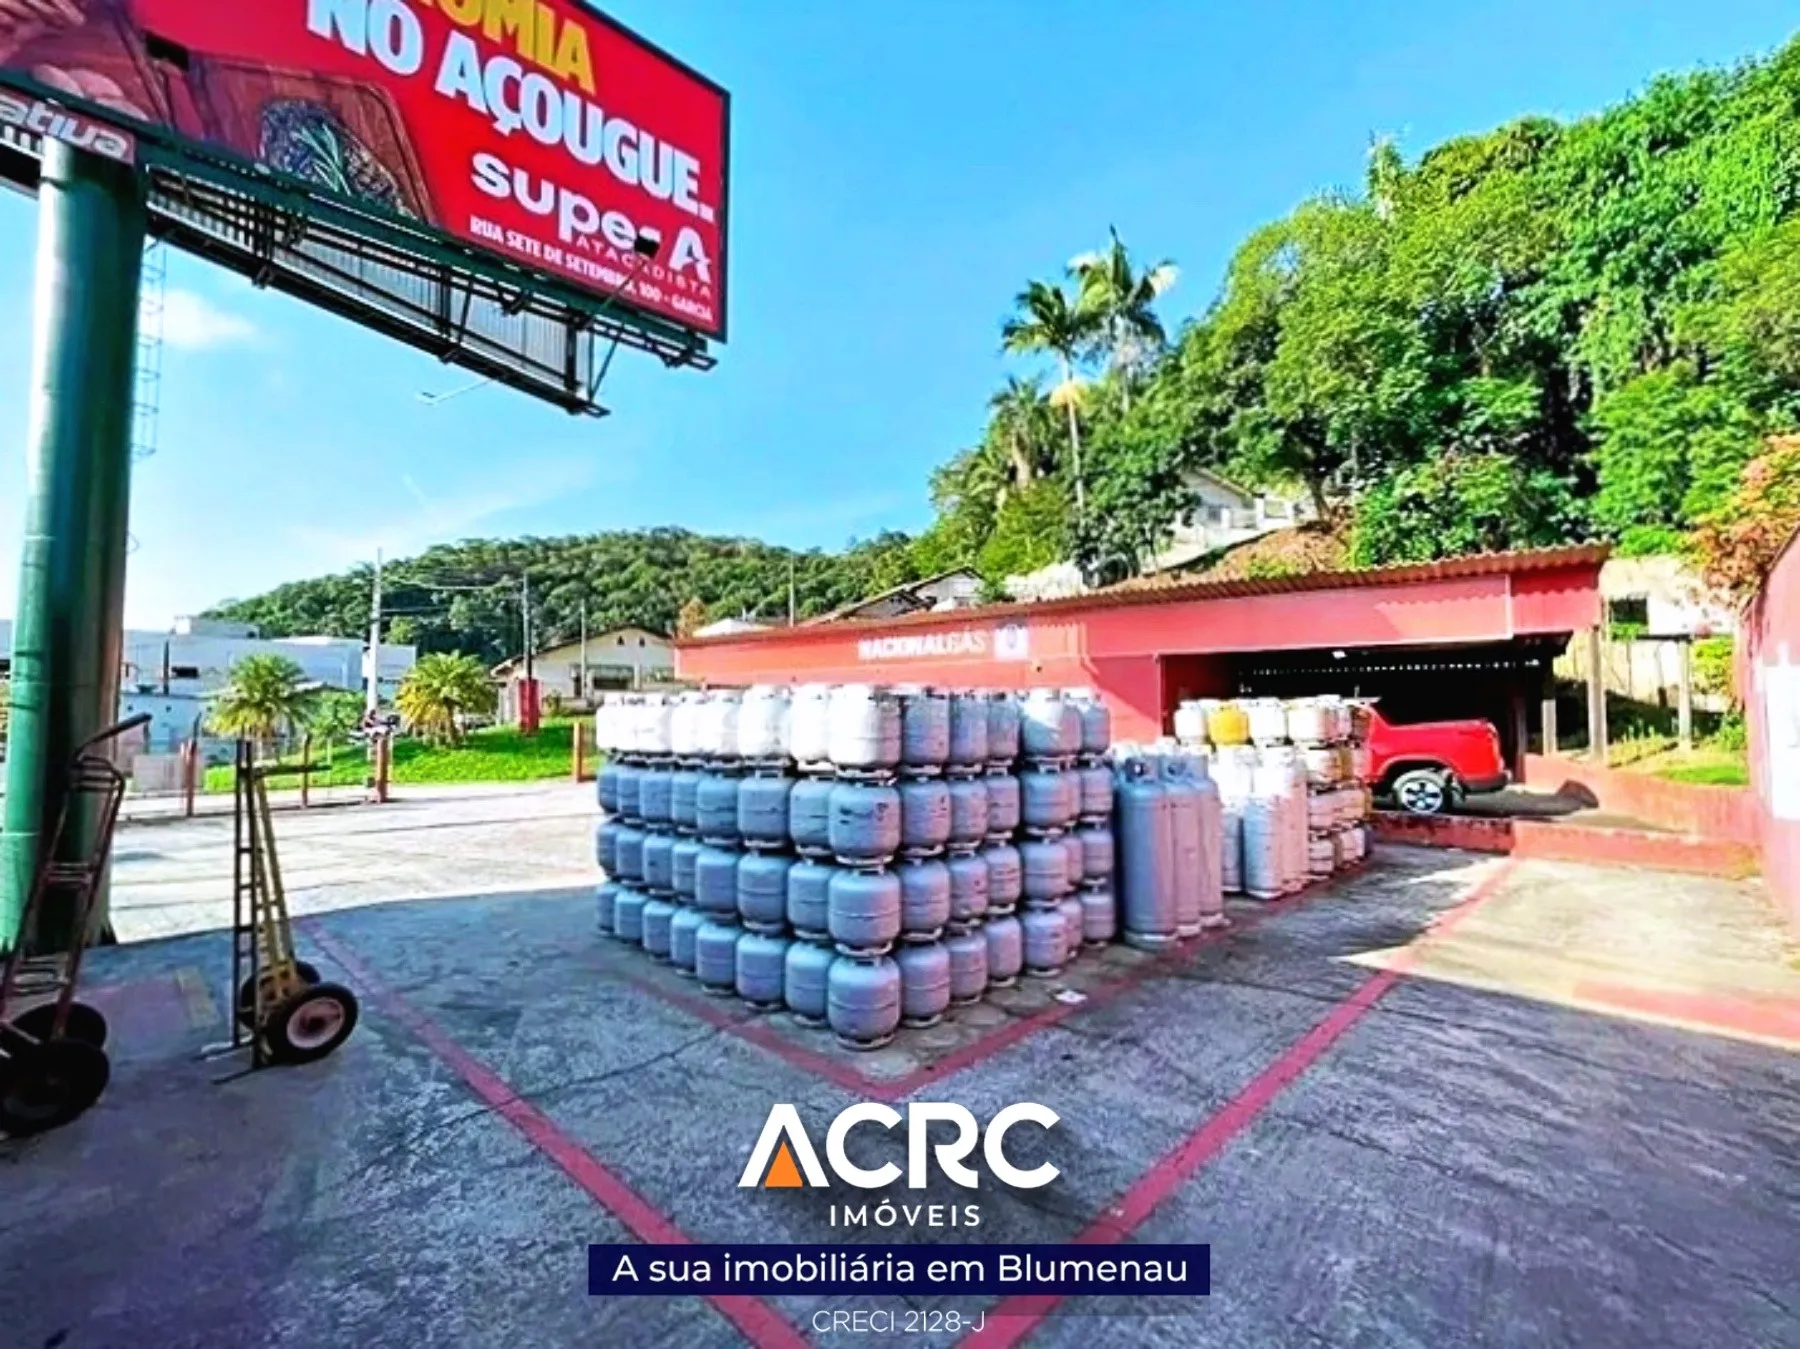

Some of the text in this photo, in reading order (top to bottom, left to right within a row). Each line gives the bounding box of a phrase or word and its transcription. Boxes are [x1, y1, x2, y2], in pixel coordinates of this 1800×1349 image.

[307, 0, 714, 221] NO AÇOUGUE.
[470, 215, 504, 243] RUA
[506, 230, 542, 259] SETE
[668, 226, 711, 284] A
